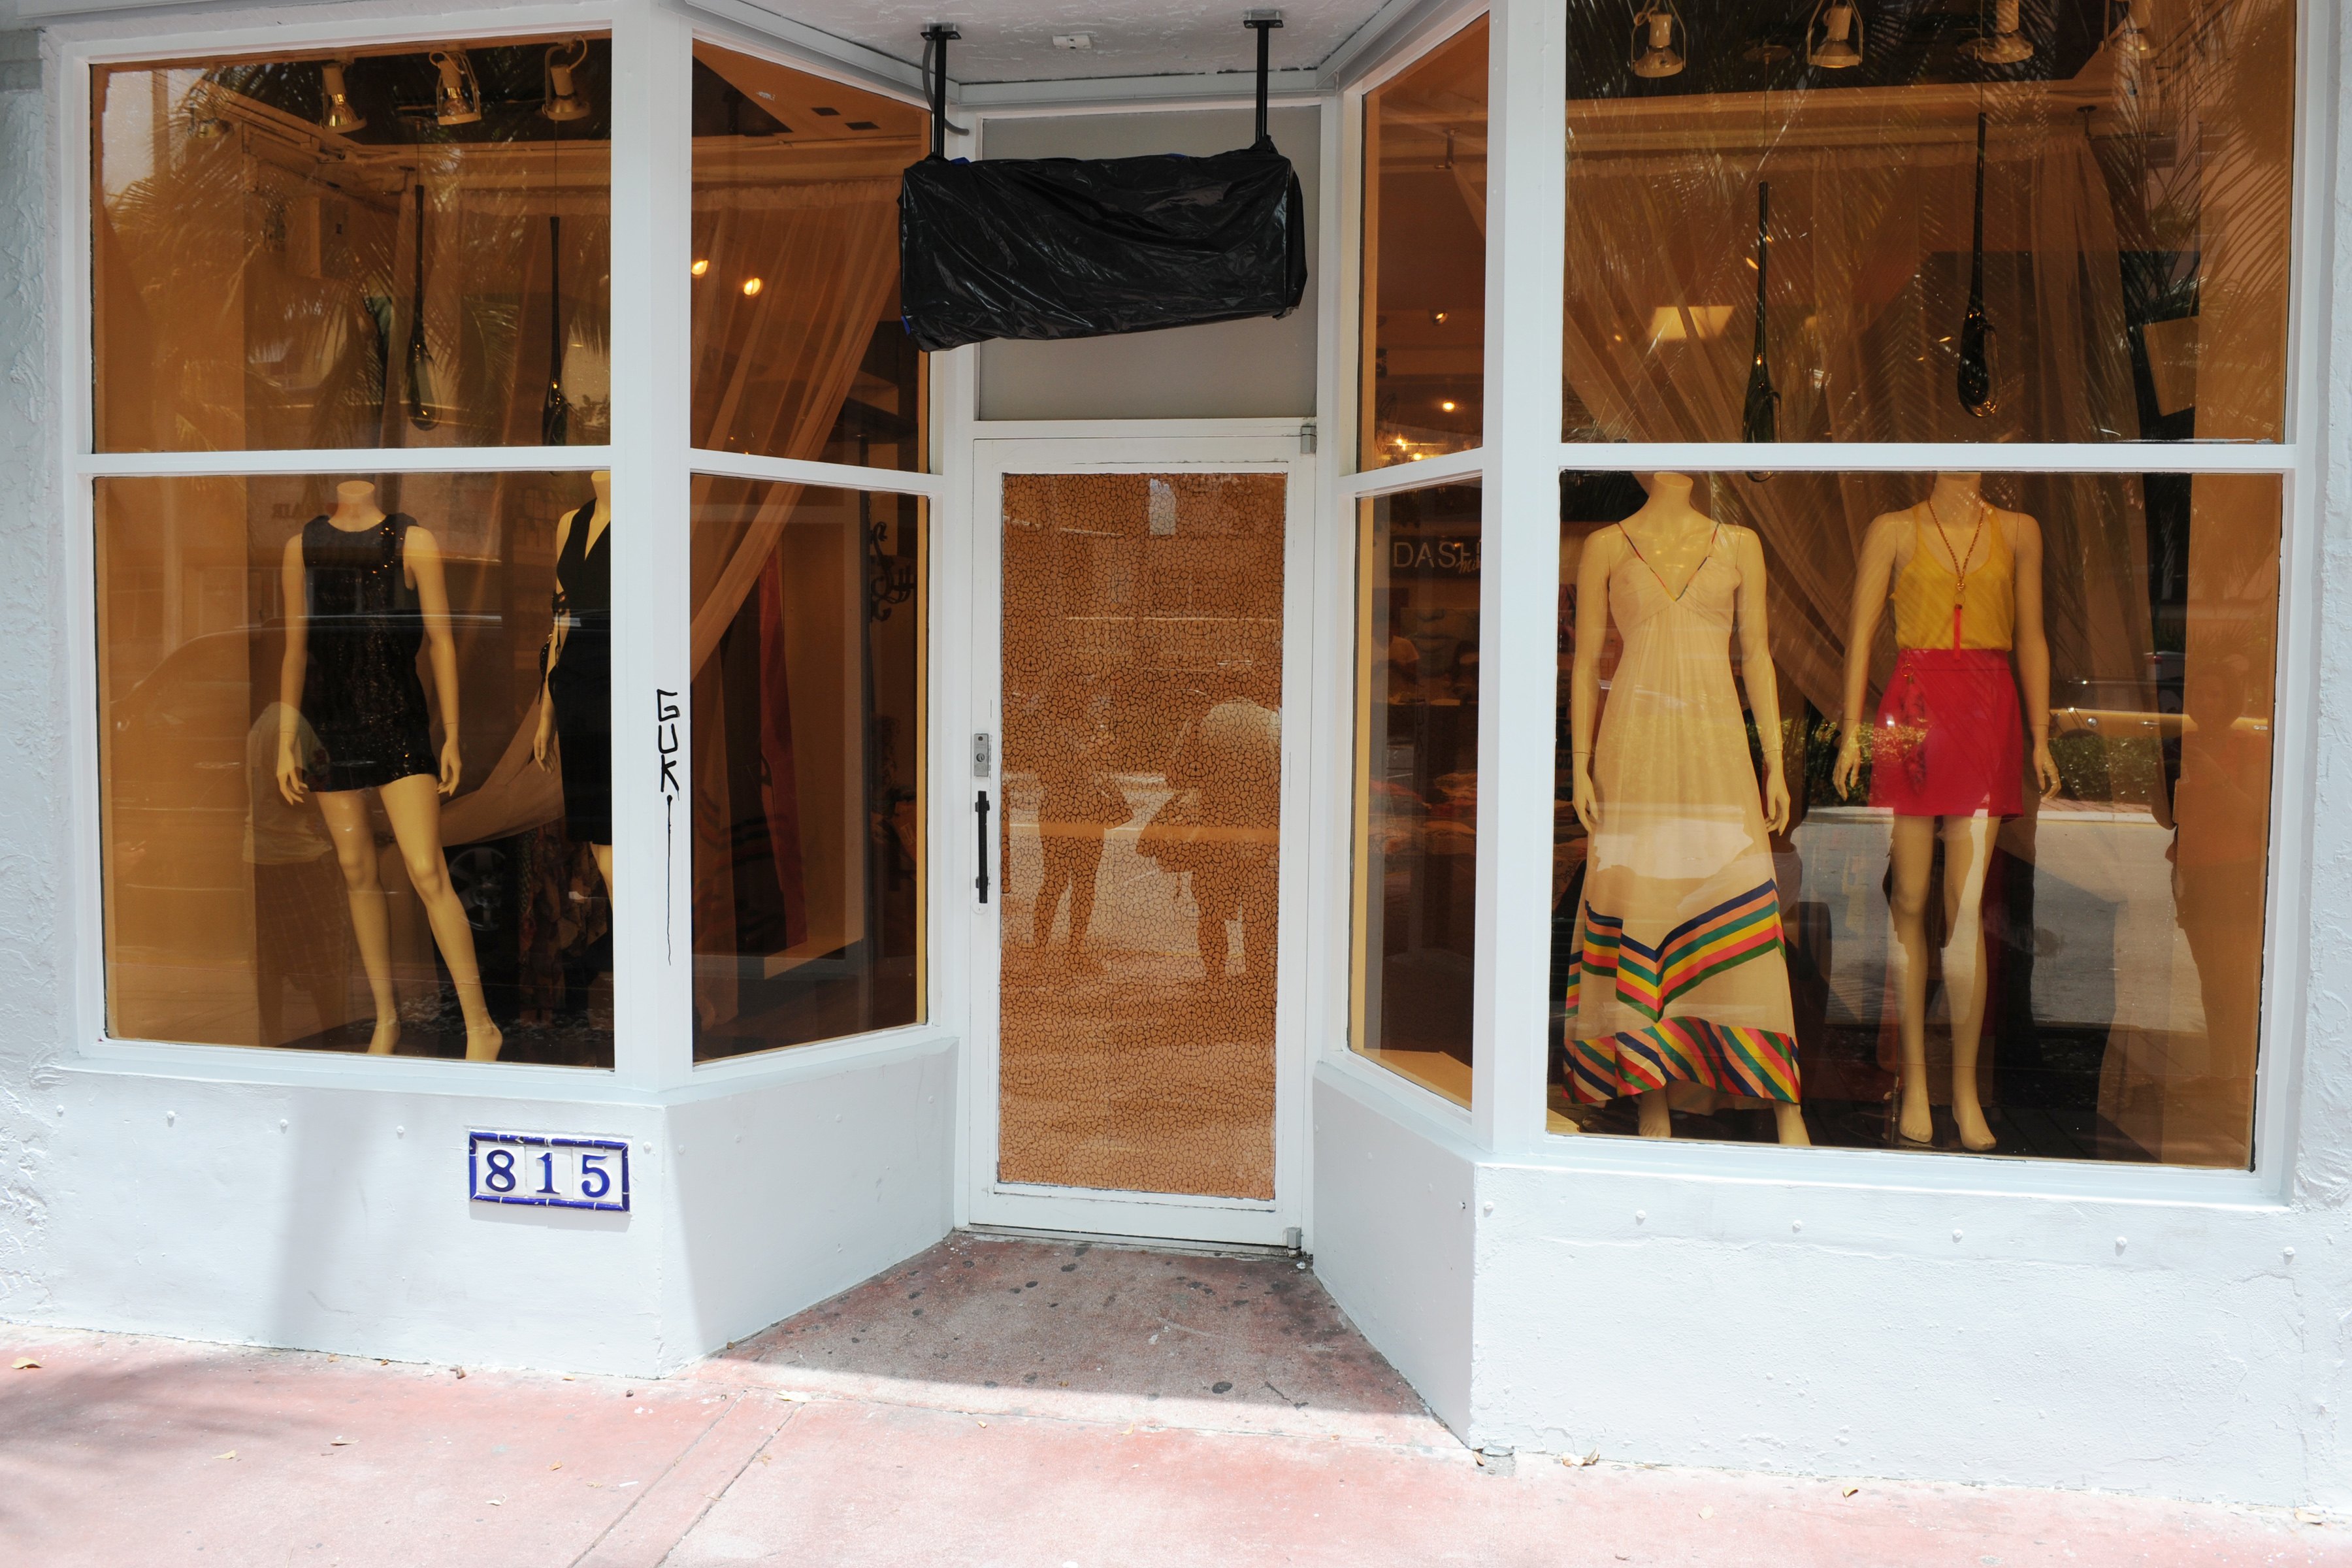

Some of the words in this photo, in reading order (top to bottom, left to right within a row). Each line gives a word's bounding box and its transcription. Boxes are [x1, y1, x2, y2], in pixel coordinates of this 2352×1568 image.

[1393, 541, 1481, 569] DASH
[656, 688, 681, 793] GUK
[485, 1149, 610, 1198] 815
